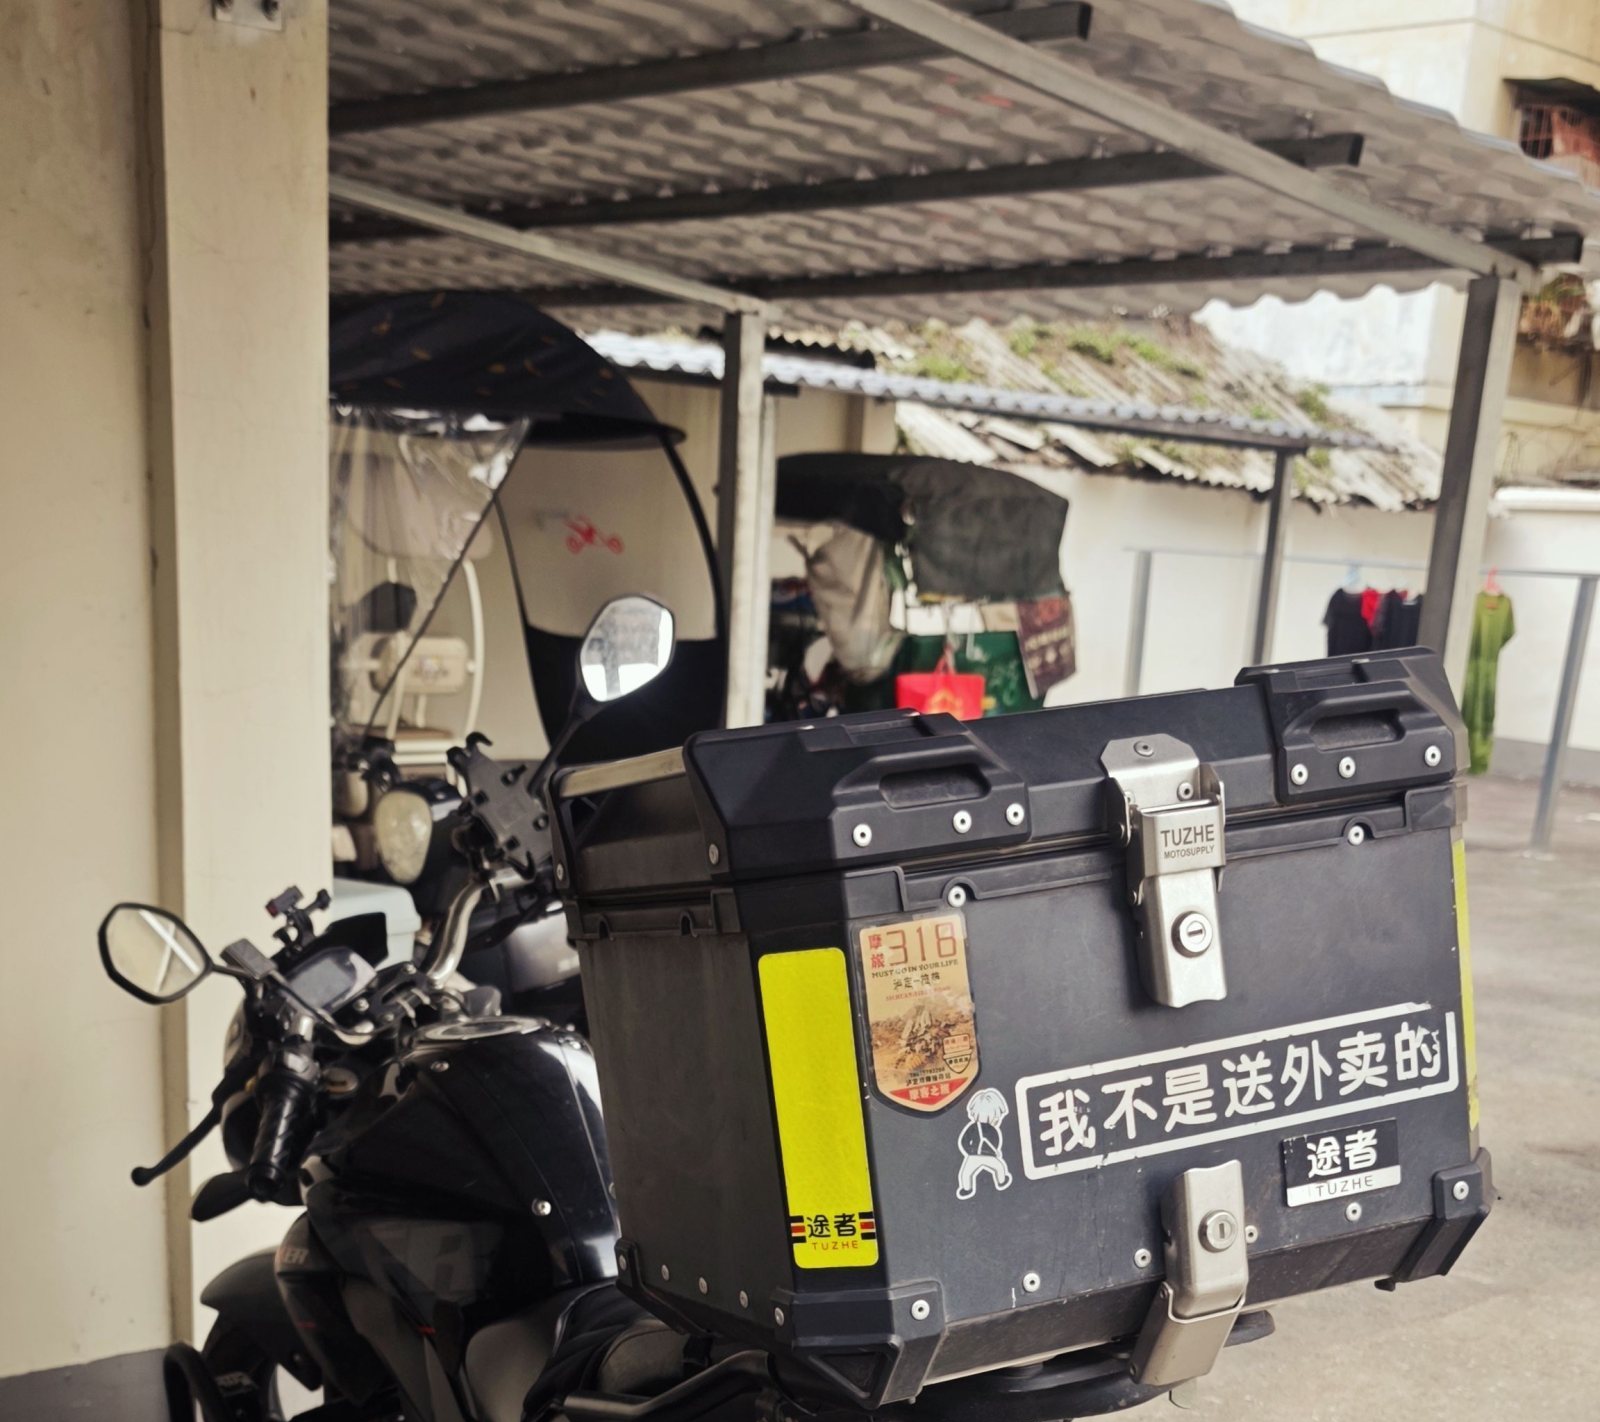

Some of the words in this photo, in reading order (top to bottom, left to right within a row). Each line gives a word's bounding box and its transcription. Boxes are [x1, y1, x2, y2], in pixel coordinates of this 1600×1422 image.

[1160, 824, 1215, 847] TUZHE
[1163, 845, 1215, 859] MOTOSUPPLY
[886, 922, 957, 967] 318
[872, 969, 894, 979] MUST
[908, 964, 917, 973] IN
[918, 961, 940, 972] YOUR
[1039, 1021, 1441, 1156] 我不是送外卖的
[1306, 1128, 1378, 1178] 途者
[1315, 1175, 1374, 1197] TUZHE
[806, 1212, 857, 1238] 途者
[811, 1240, 859, 1251] TUZHE
